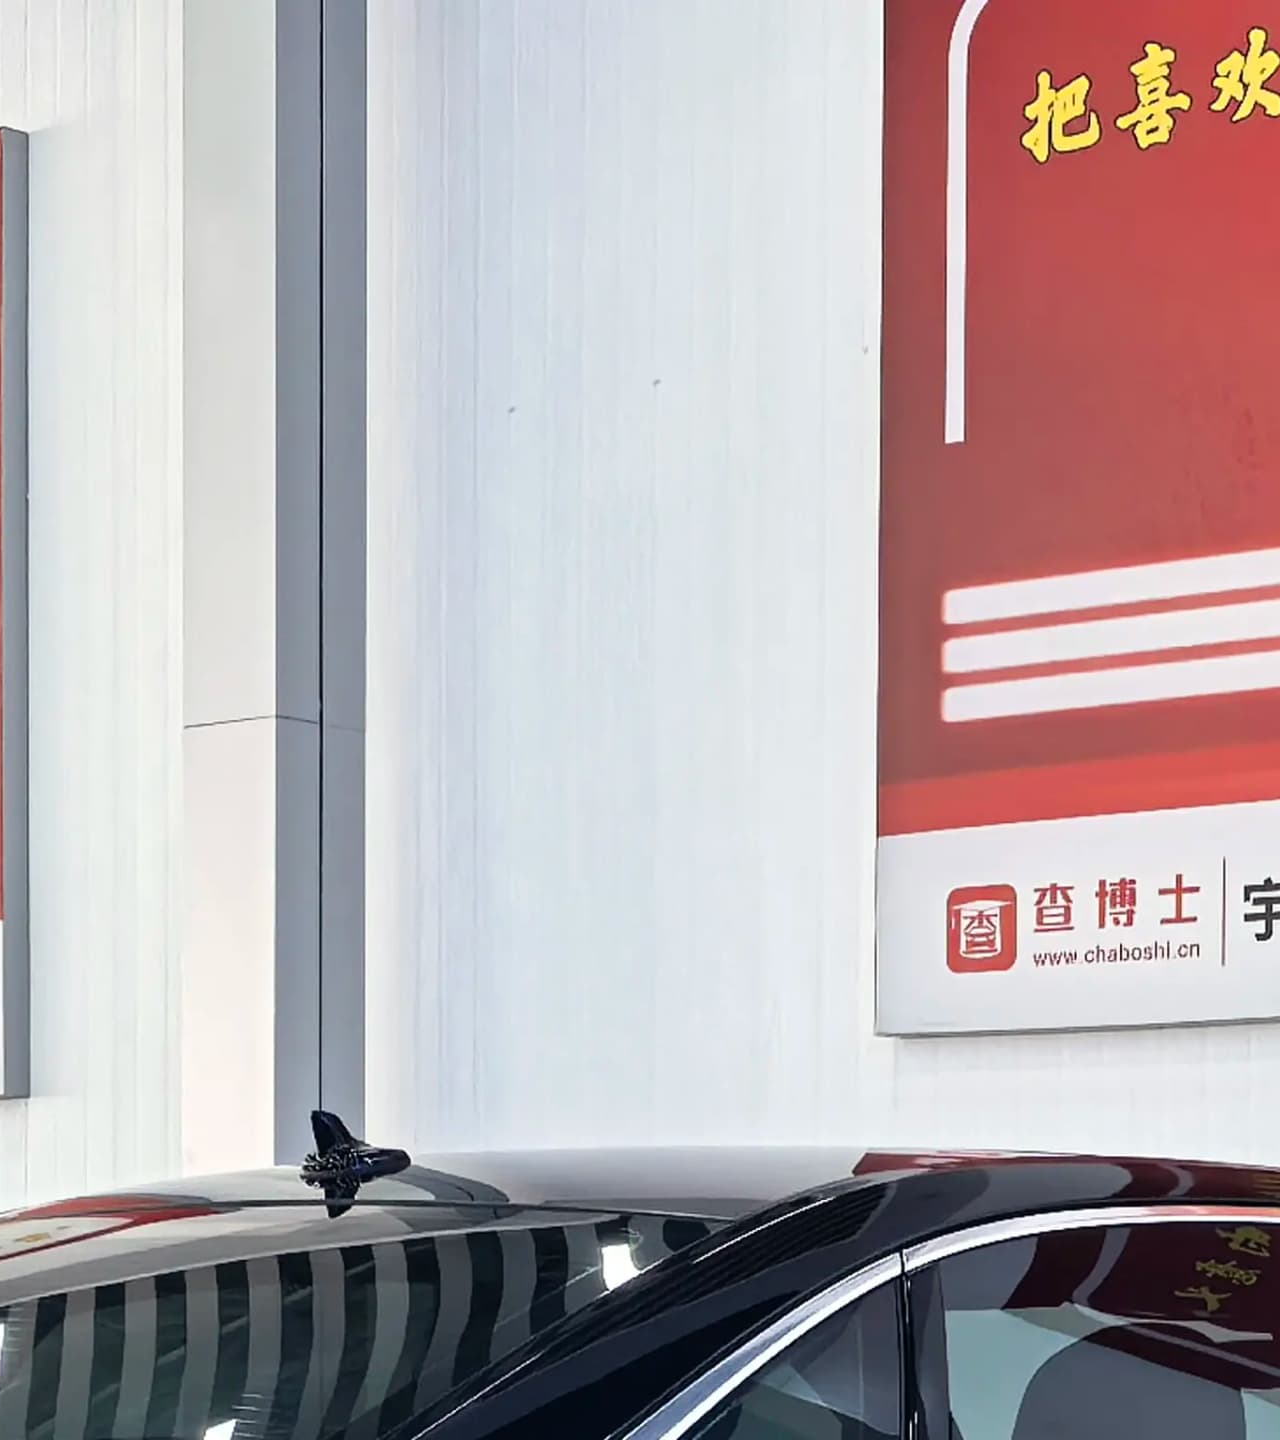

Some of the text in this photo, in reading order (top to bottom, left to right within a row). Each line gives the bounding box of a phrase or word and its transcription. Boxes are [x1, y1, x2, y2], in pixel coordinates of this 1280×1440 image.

[1033, 873, 1201, 933] 查博士
[1033, 941, 1201, 968] www.chaboshi.cn
